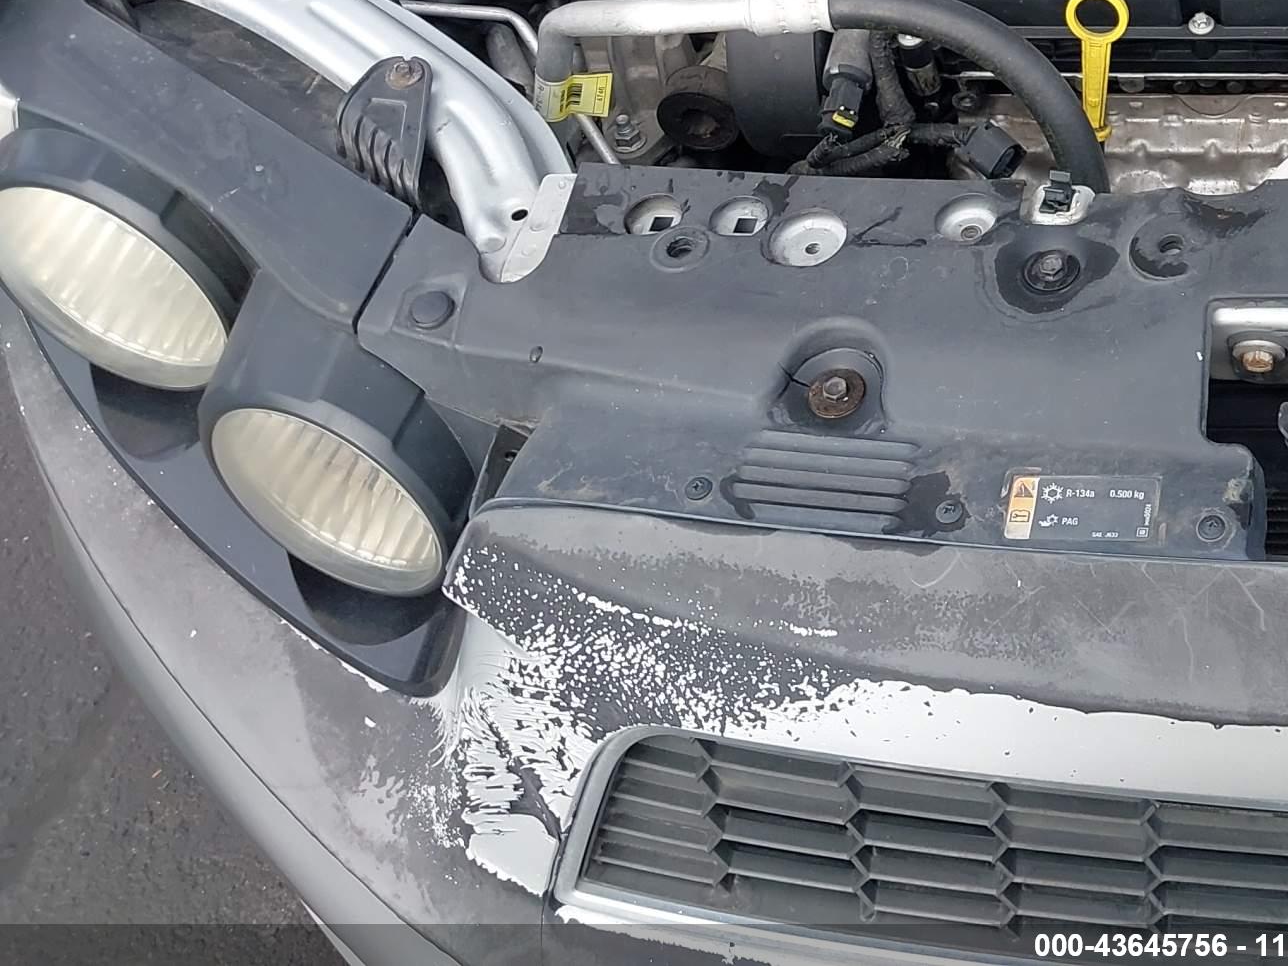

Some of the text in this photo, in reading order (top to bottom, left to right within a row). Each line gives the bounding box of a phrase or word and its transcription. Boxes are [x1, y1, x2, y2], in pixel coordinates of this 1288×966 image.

[1066, 490, 1145, 500] R-134a 0.500 kg
[1062, 518, 1078, 526] PAG
